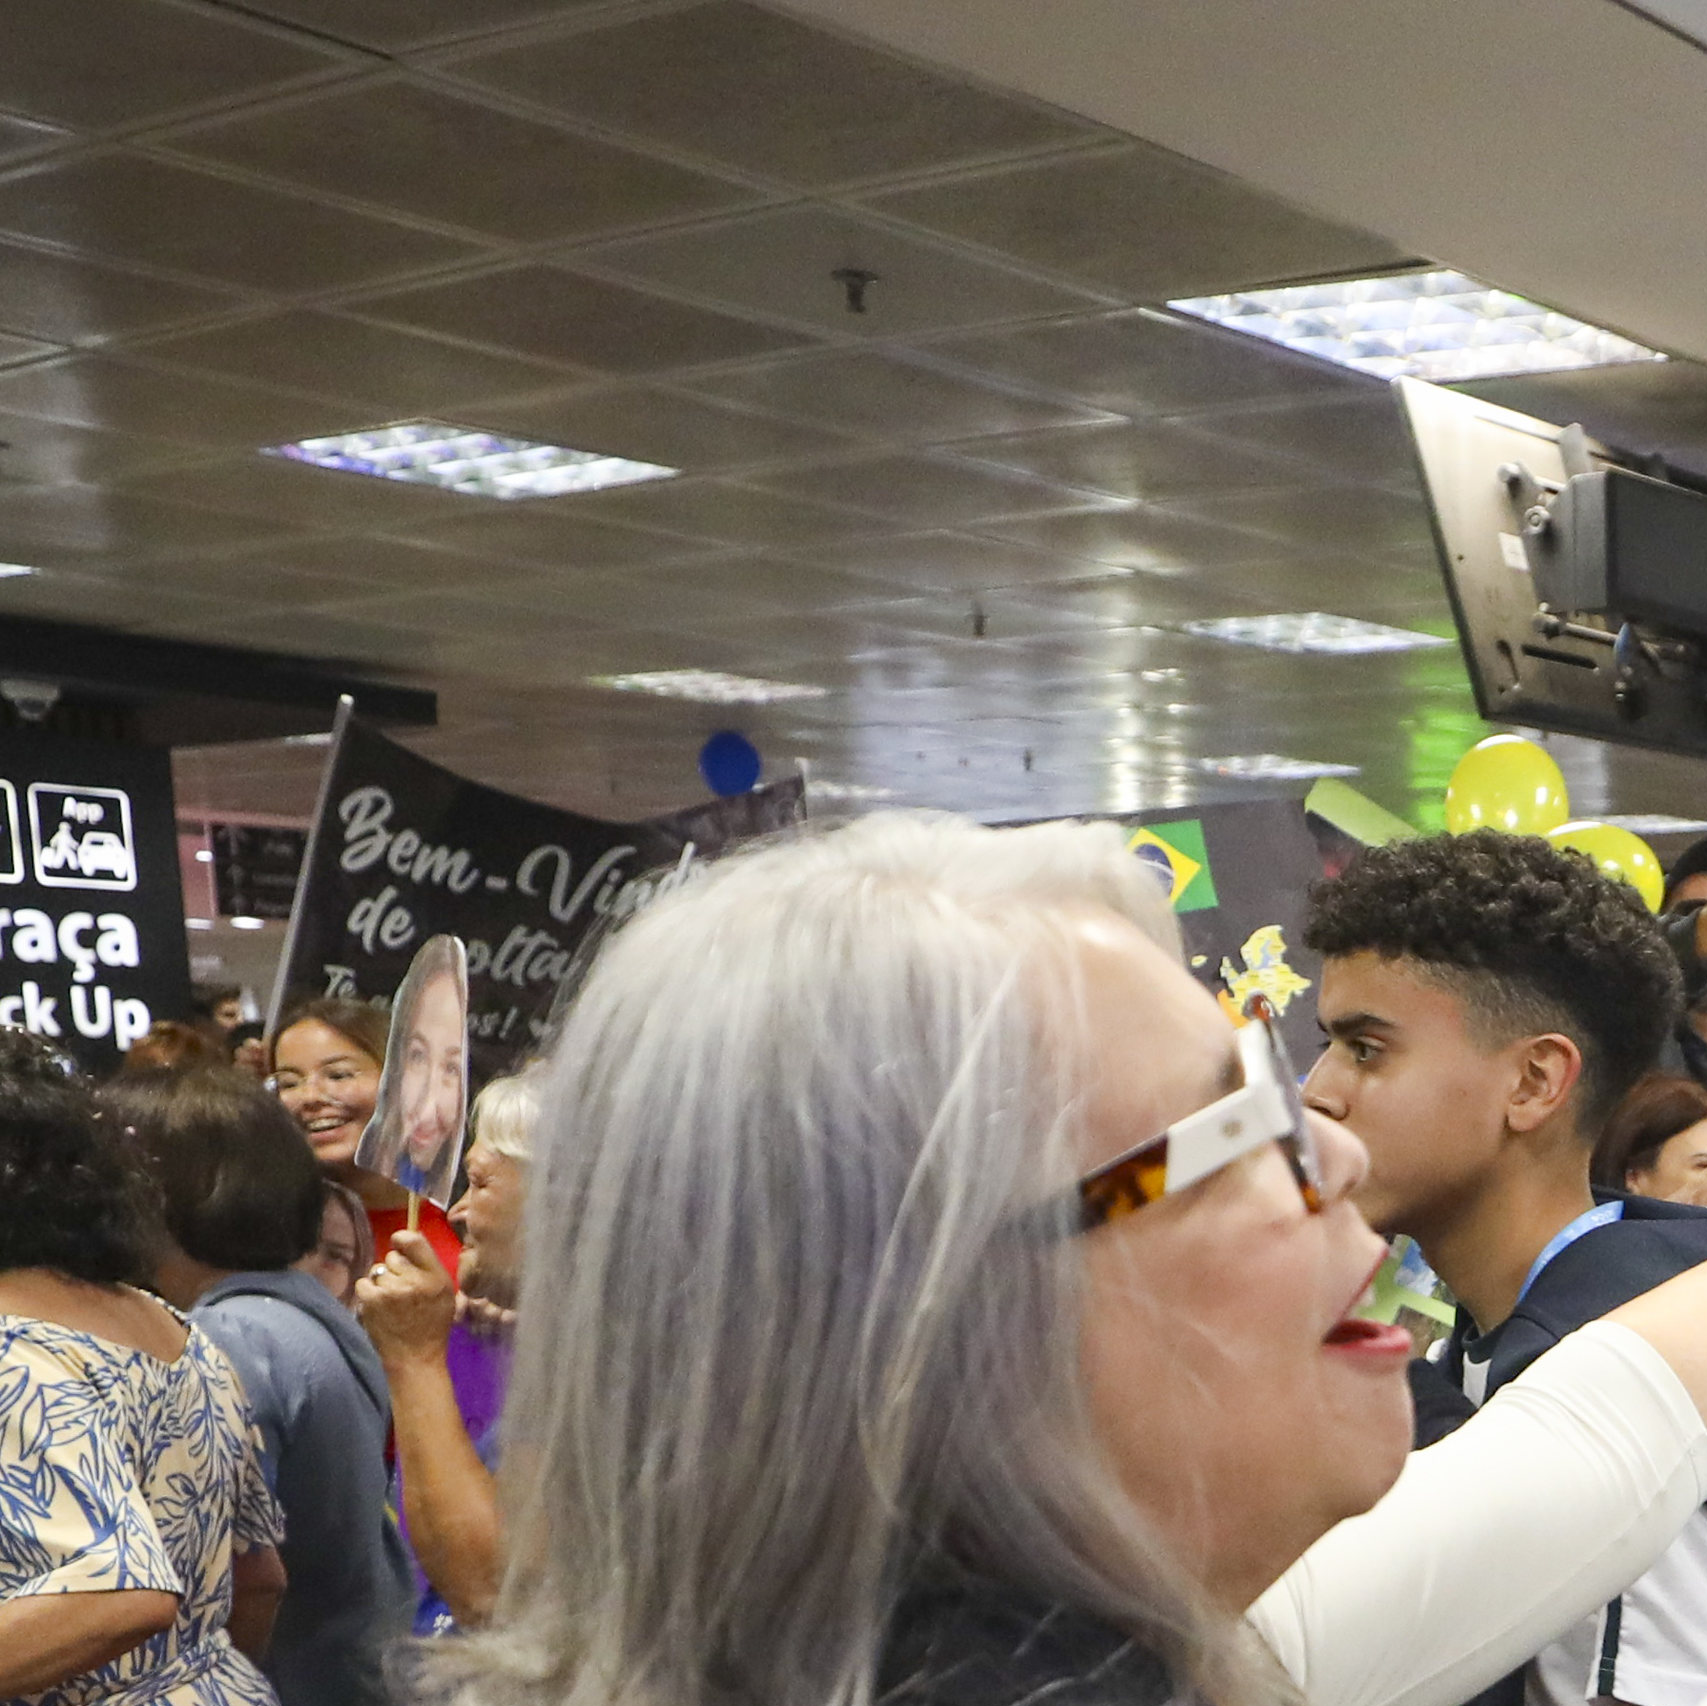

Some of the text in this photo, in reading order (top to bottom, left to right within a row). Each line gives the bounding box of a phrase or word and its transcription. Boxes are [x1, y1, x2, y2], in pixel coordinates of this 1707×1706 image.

[346, 885, 418, 955] de
[466, 924, 581, 988] olta
[69, 984, 152, 1052] Up
